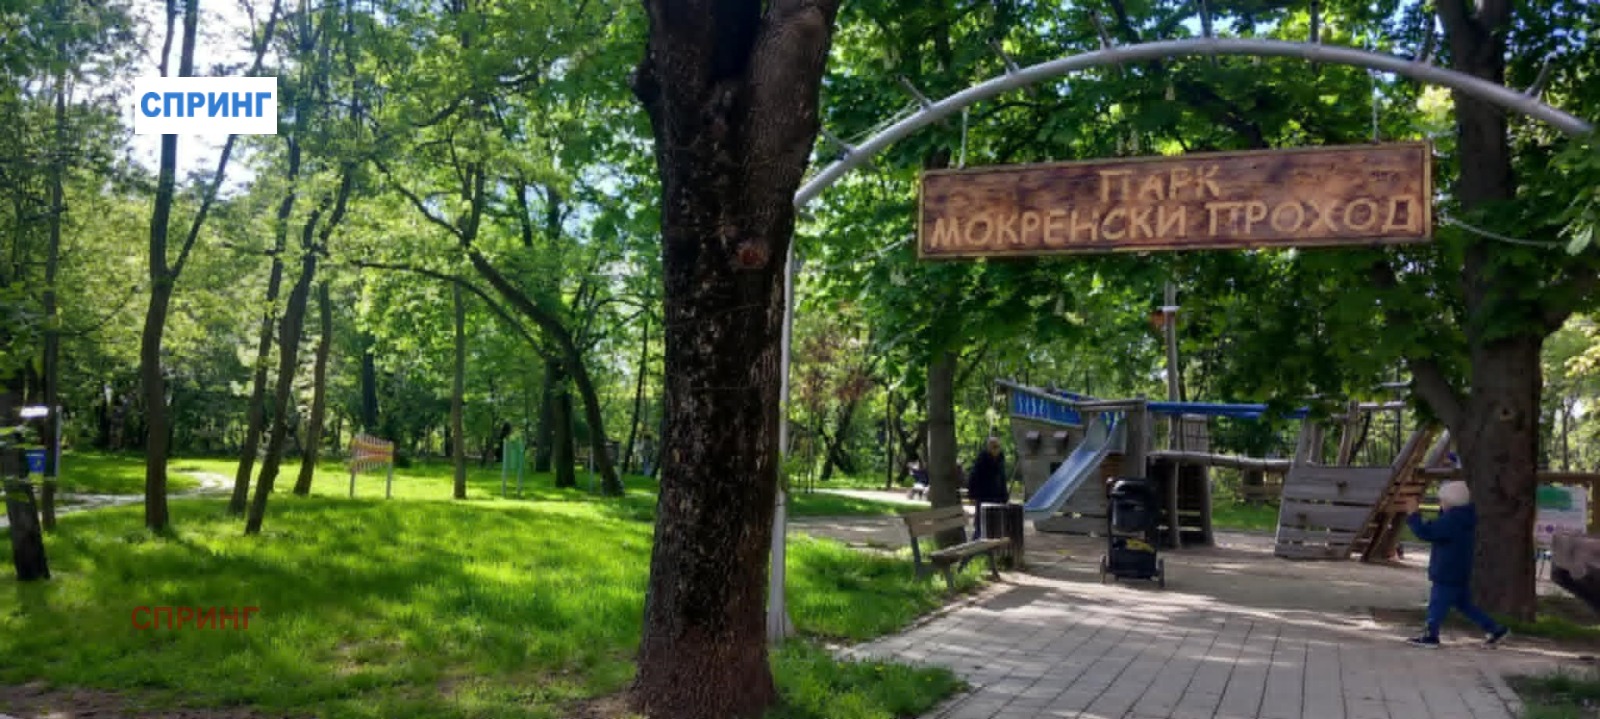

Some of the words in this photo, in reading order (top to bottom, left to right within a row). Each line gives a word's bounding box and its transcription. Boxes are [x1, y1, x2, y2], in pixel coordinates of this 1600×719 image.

[1100, 165, 1220, 202] ПАРК
[932, 205, 1188, 248] МОКРЕНСКИ
[1205, 196, 1419, 237] ПРОХОД
